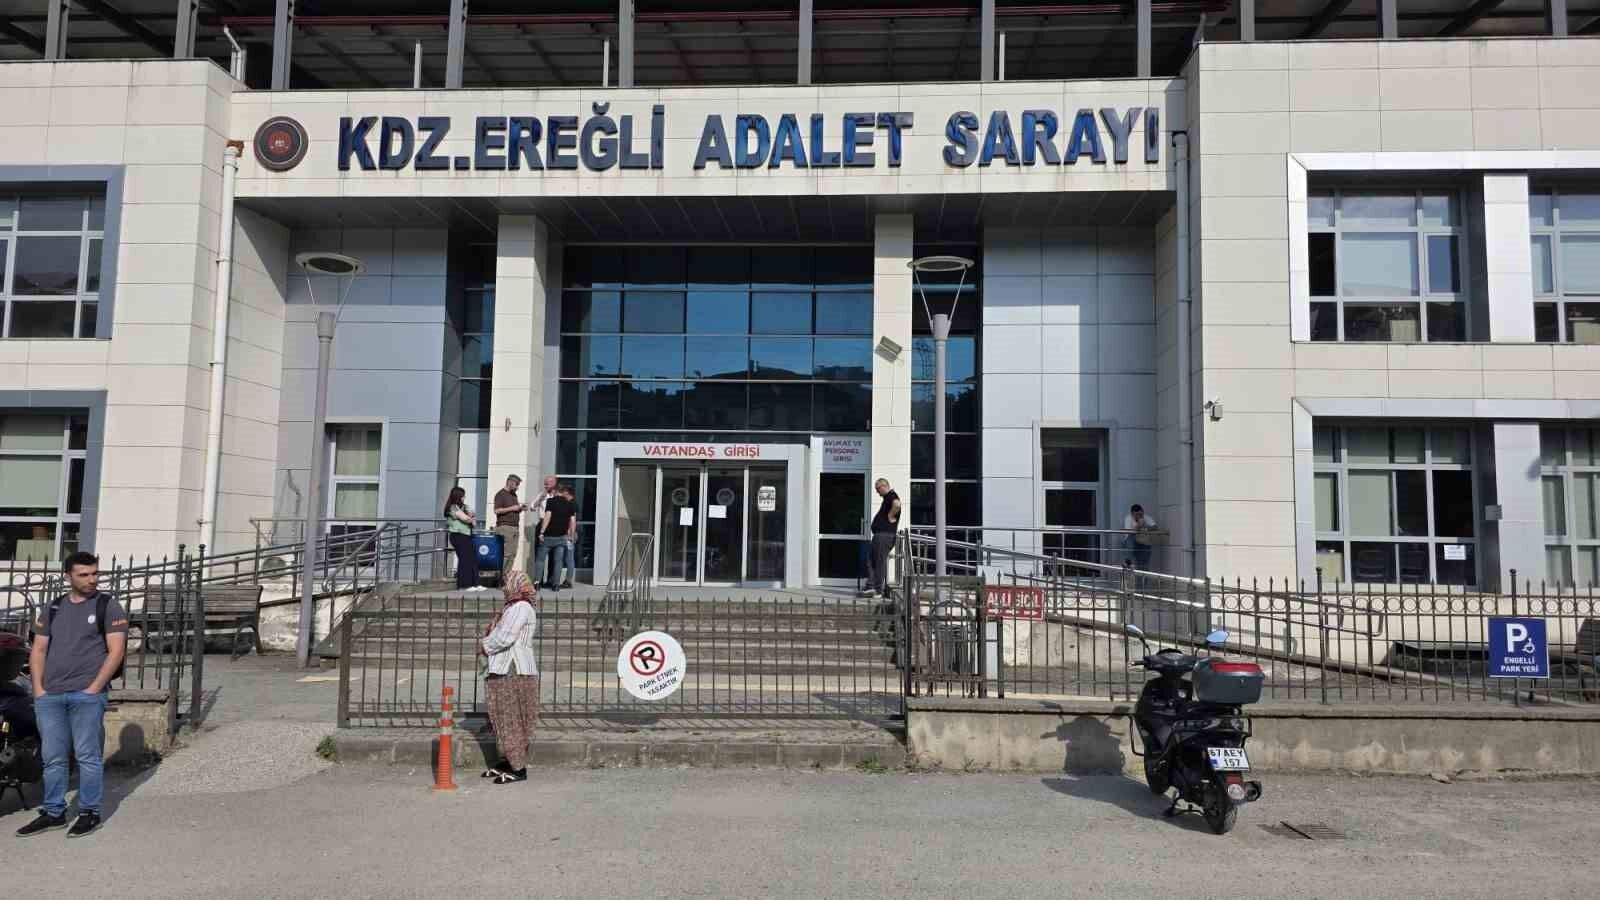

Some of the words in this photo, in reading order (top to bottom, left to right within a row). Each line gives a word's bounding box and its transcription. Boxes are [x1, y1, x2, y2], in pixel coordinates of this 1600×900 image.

[338, 102, 664, 172] KDZ.EREĞLİ
[693, 111, 914, 170] ADALET
[942, 107, 1160, 168] SARAYI
[642, 445, 715, 458] VATANDAŞ
[723, 444, 761, 458] GİRİŞİ
[1506, 623, 1528, 653] P
[1504, 655, 1535, 664] ENGELLİ
[1521, 664, 1539, 672] YERİ
[639, 680, 657, 690] PARK
[656, 666, 679, 681] ETMEK
[1223, 749, 1243, 757] AEY
[1223, 758, 1240, 766] 157
